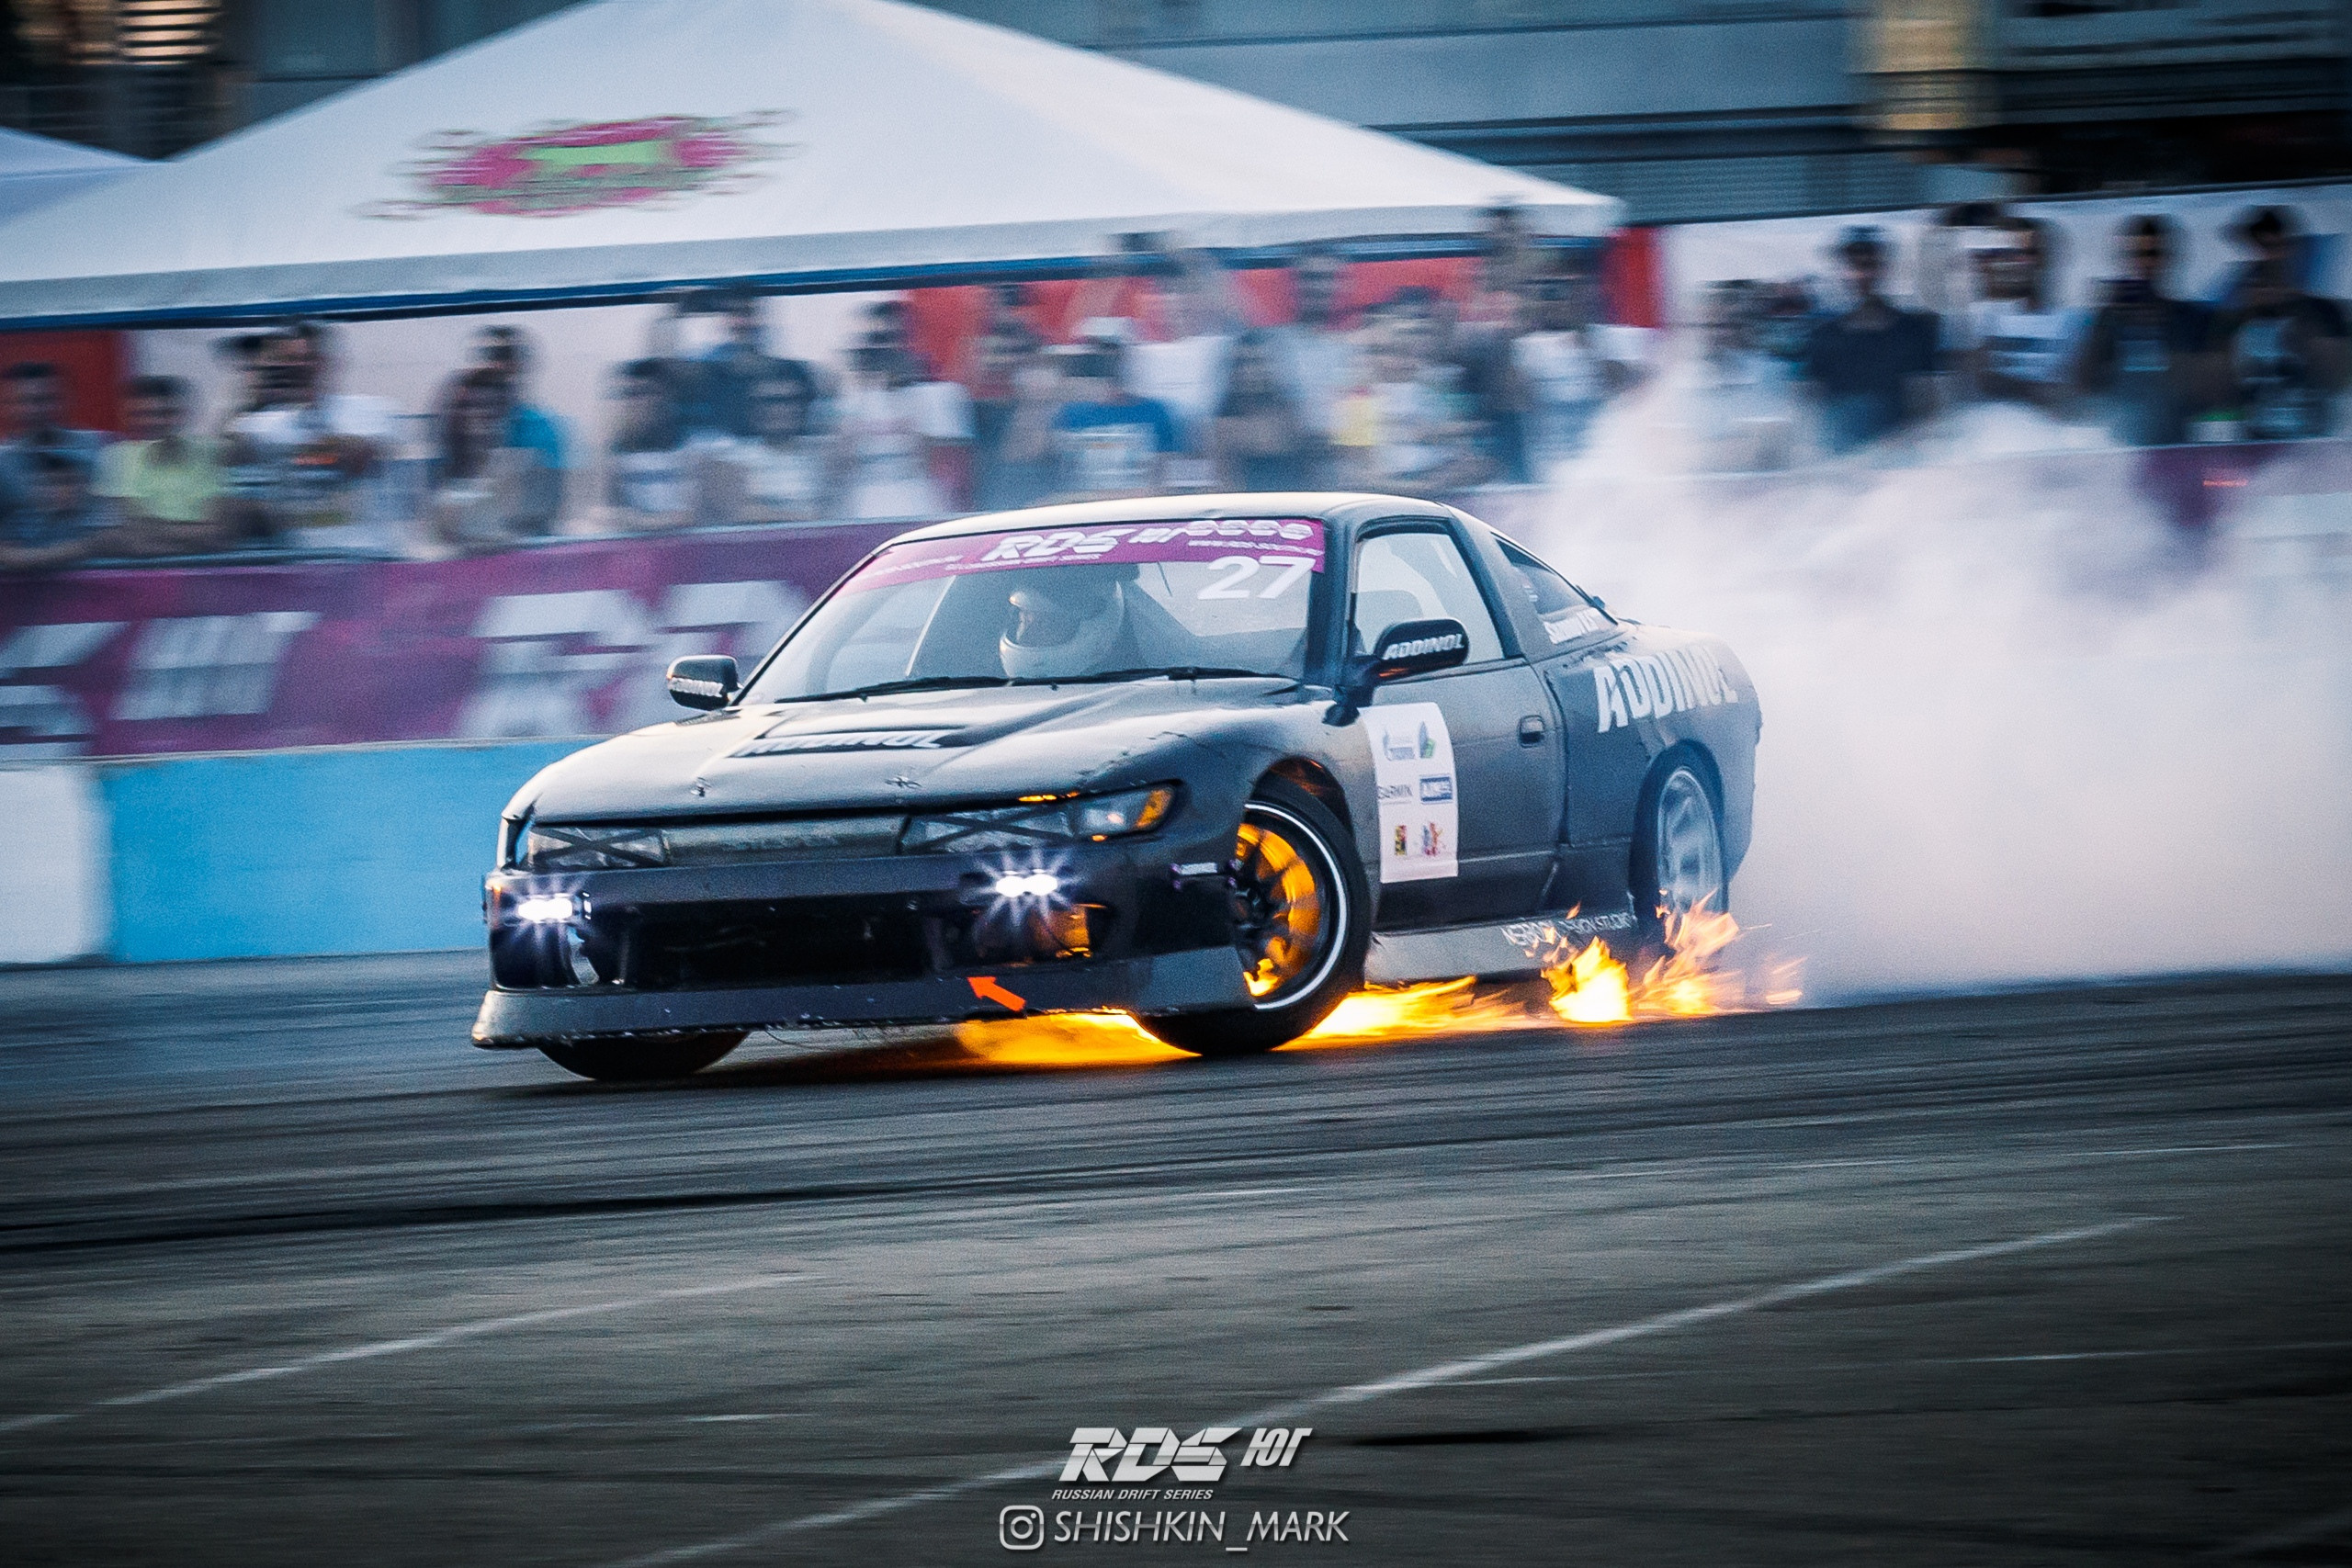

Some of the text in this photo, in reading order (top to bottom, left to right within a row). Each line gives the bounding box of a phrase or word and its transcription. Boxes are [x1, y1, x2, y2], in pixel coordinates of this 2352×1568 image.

[980, 527, 1138, 562] RDS
[1197, 555, 1317, 599] 27
[1382, 633, 1464, 660] ADDINOL
[1593, 642, 1739, 733] ADDINOL
